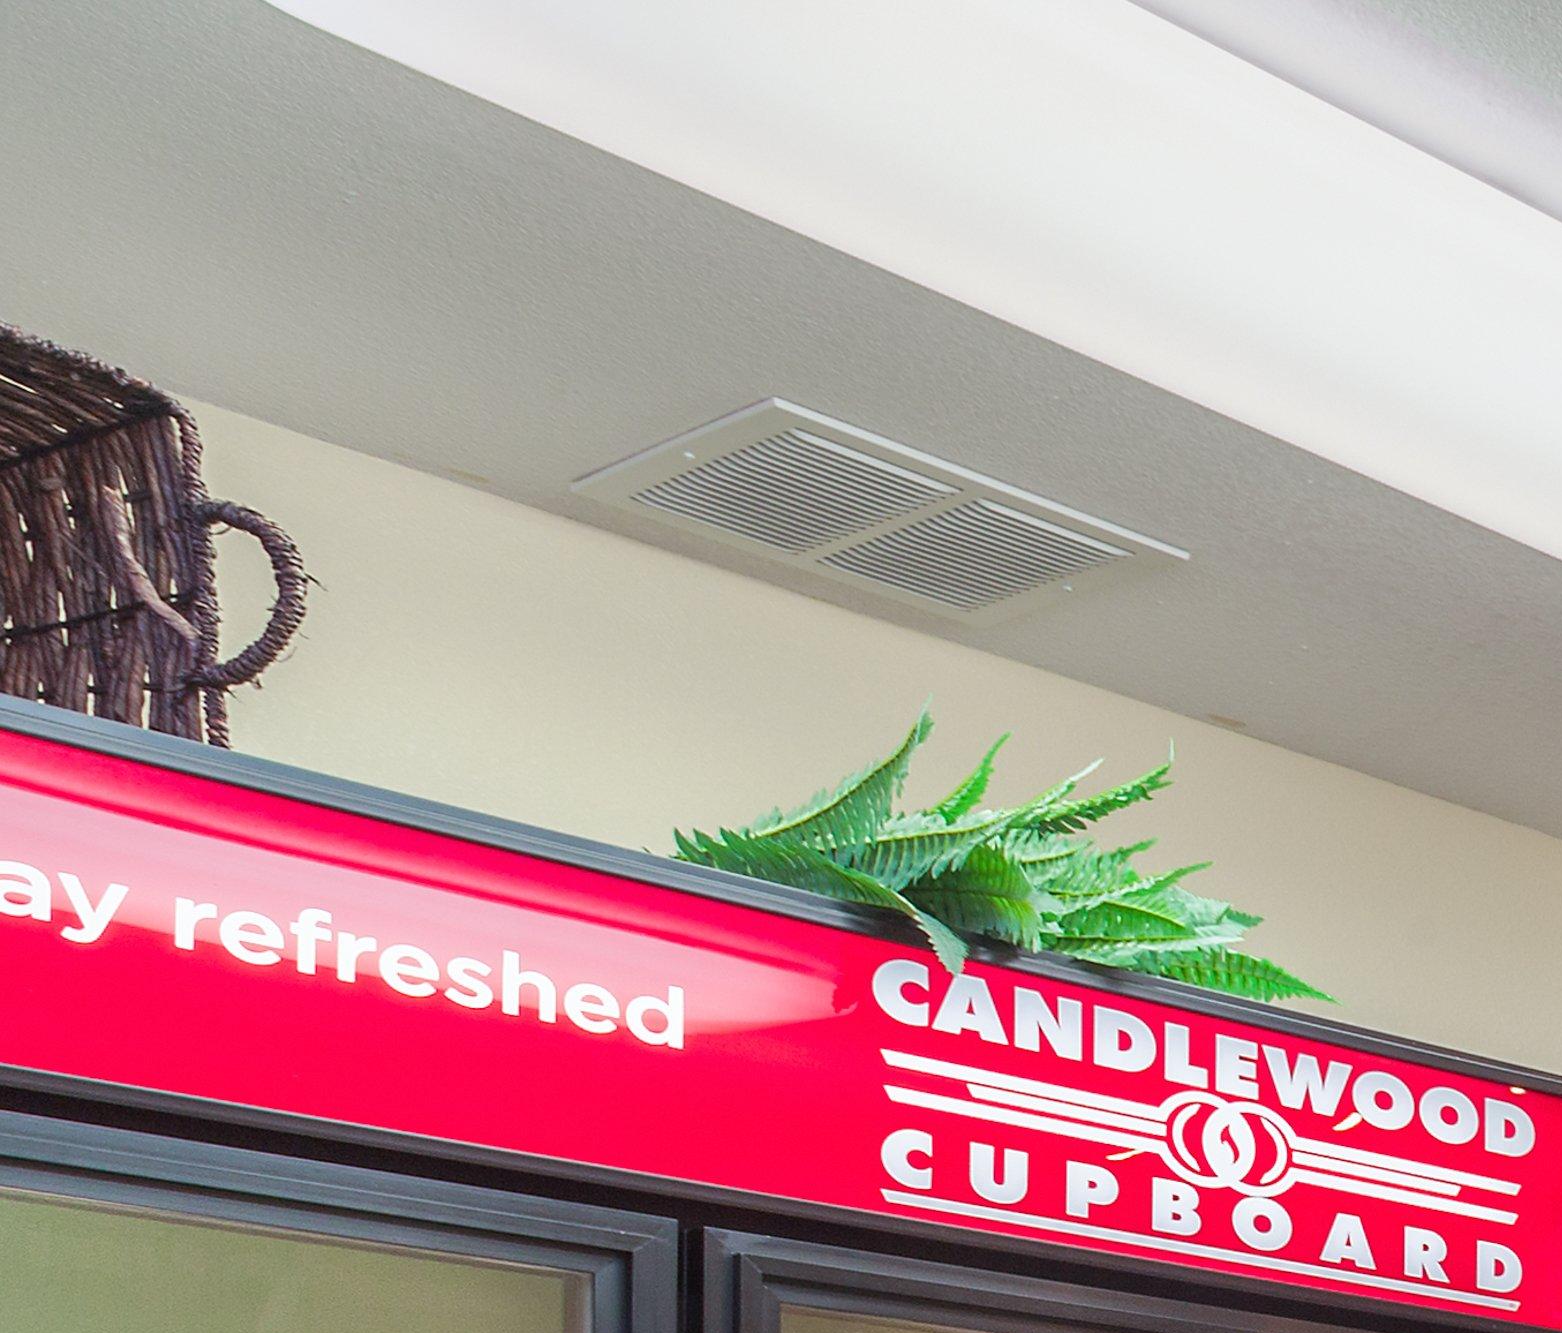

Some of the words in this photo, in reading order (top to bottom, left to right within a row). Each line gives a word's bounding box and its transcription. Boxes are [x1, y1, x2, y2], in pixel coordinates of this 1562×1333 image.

[174, 895, 686, 1050] refreshed
[871, 959, 1536, 1158] CANDLEWOOD
[880, 1129, 1523, 1294] CUPBOARD
